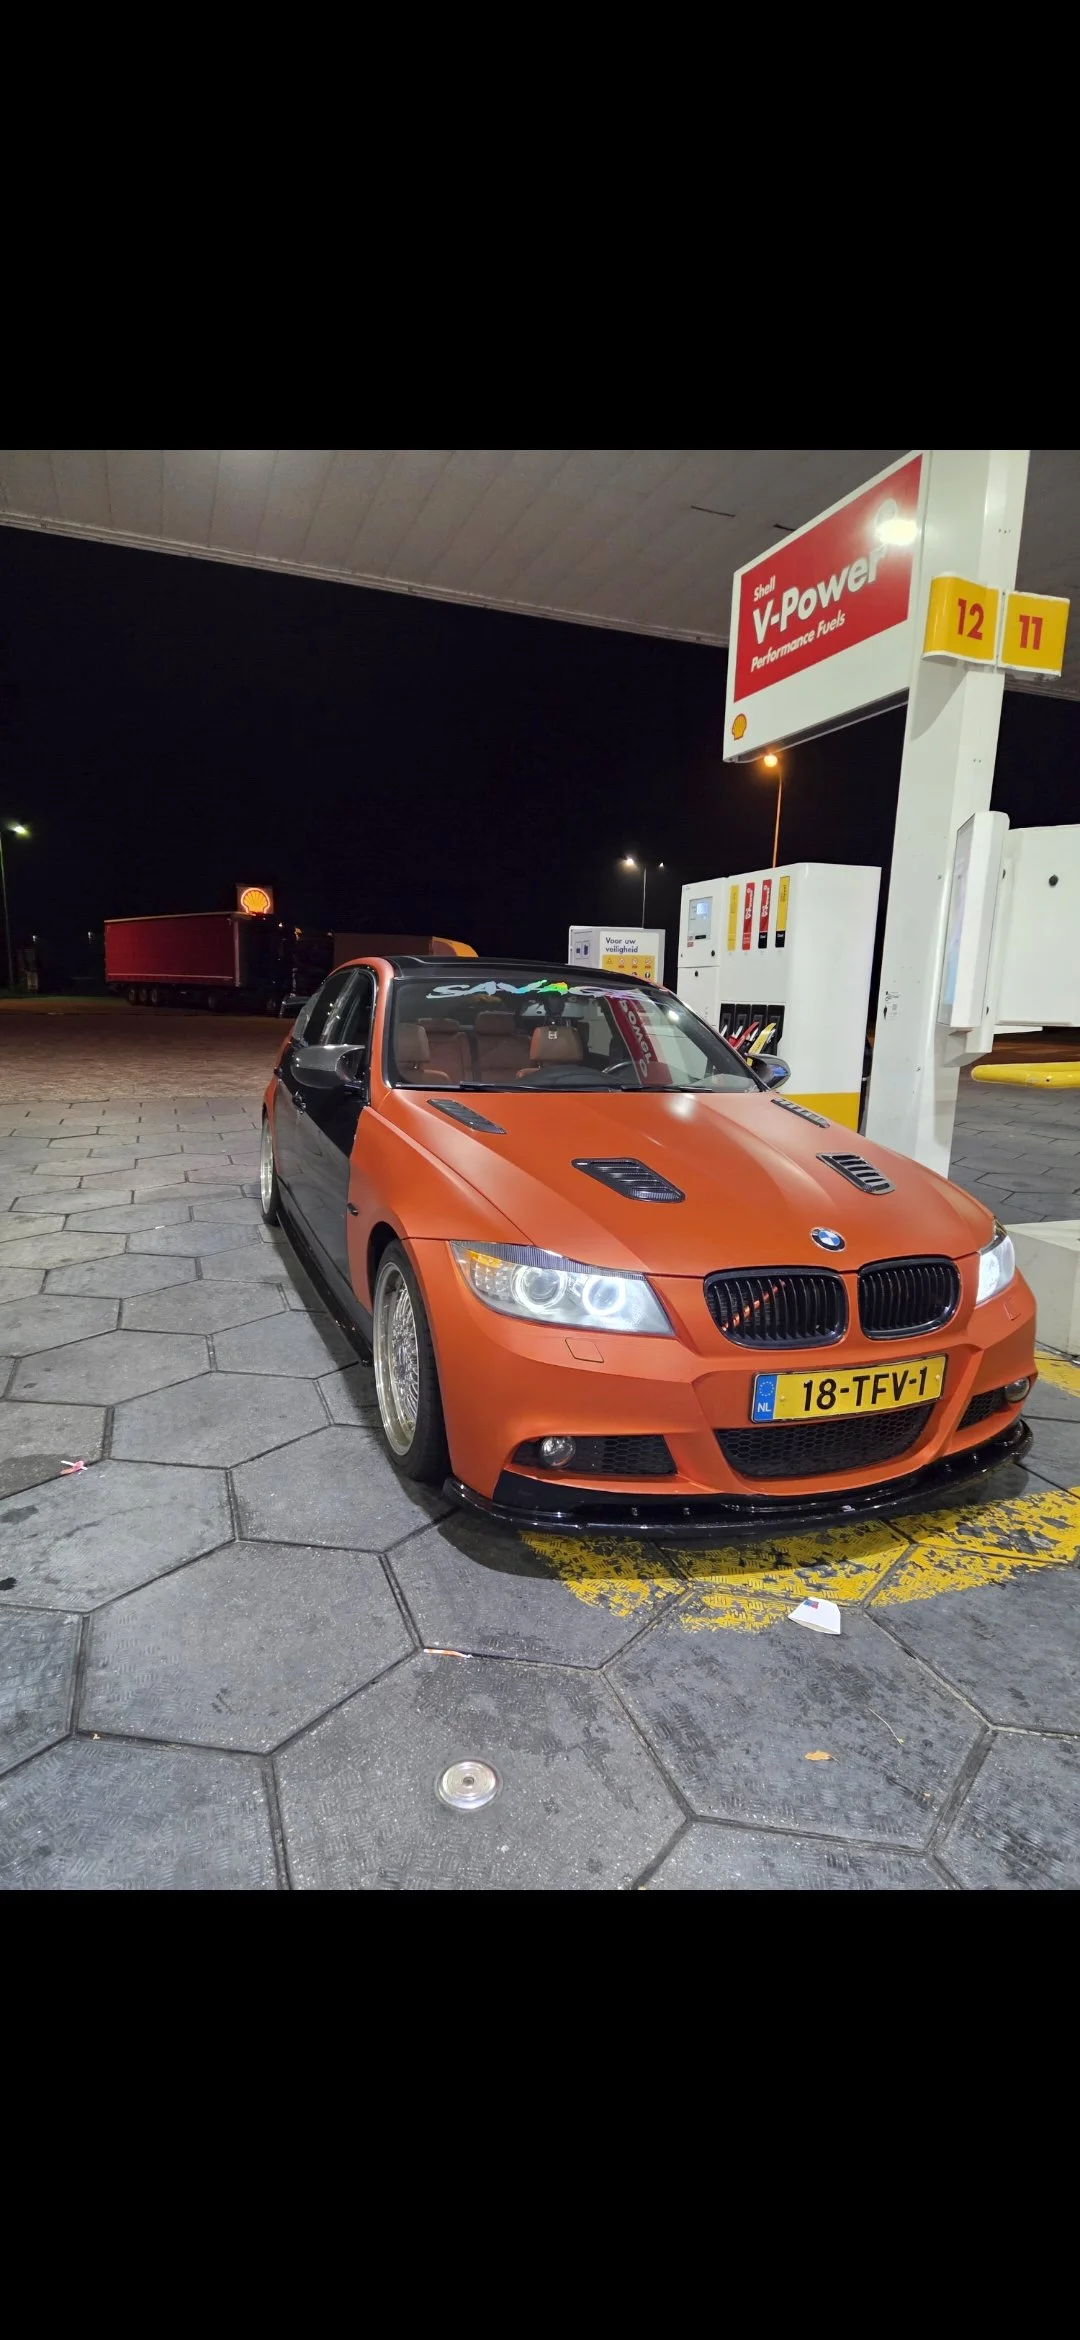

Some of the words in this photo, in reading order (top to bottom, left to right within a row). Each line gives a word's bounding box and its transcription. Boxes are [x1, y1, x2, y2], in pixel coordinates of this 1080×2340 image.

[753, 574, 776, 602] Shell
[753, 545, 888, 645] V-Power
[957, 598, 985, 641] 12
[1019, 615, 1044, 651] 11
[750, 629, 816, 673] Performance
[816, 609, 846, 639] Fuels
[605, 946, 639, 954] veiligheid
[757, 1402, 771, 1414] NL
[803, 1367, 928, 1412] 18-TFV-1
